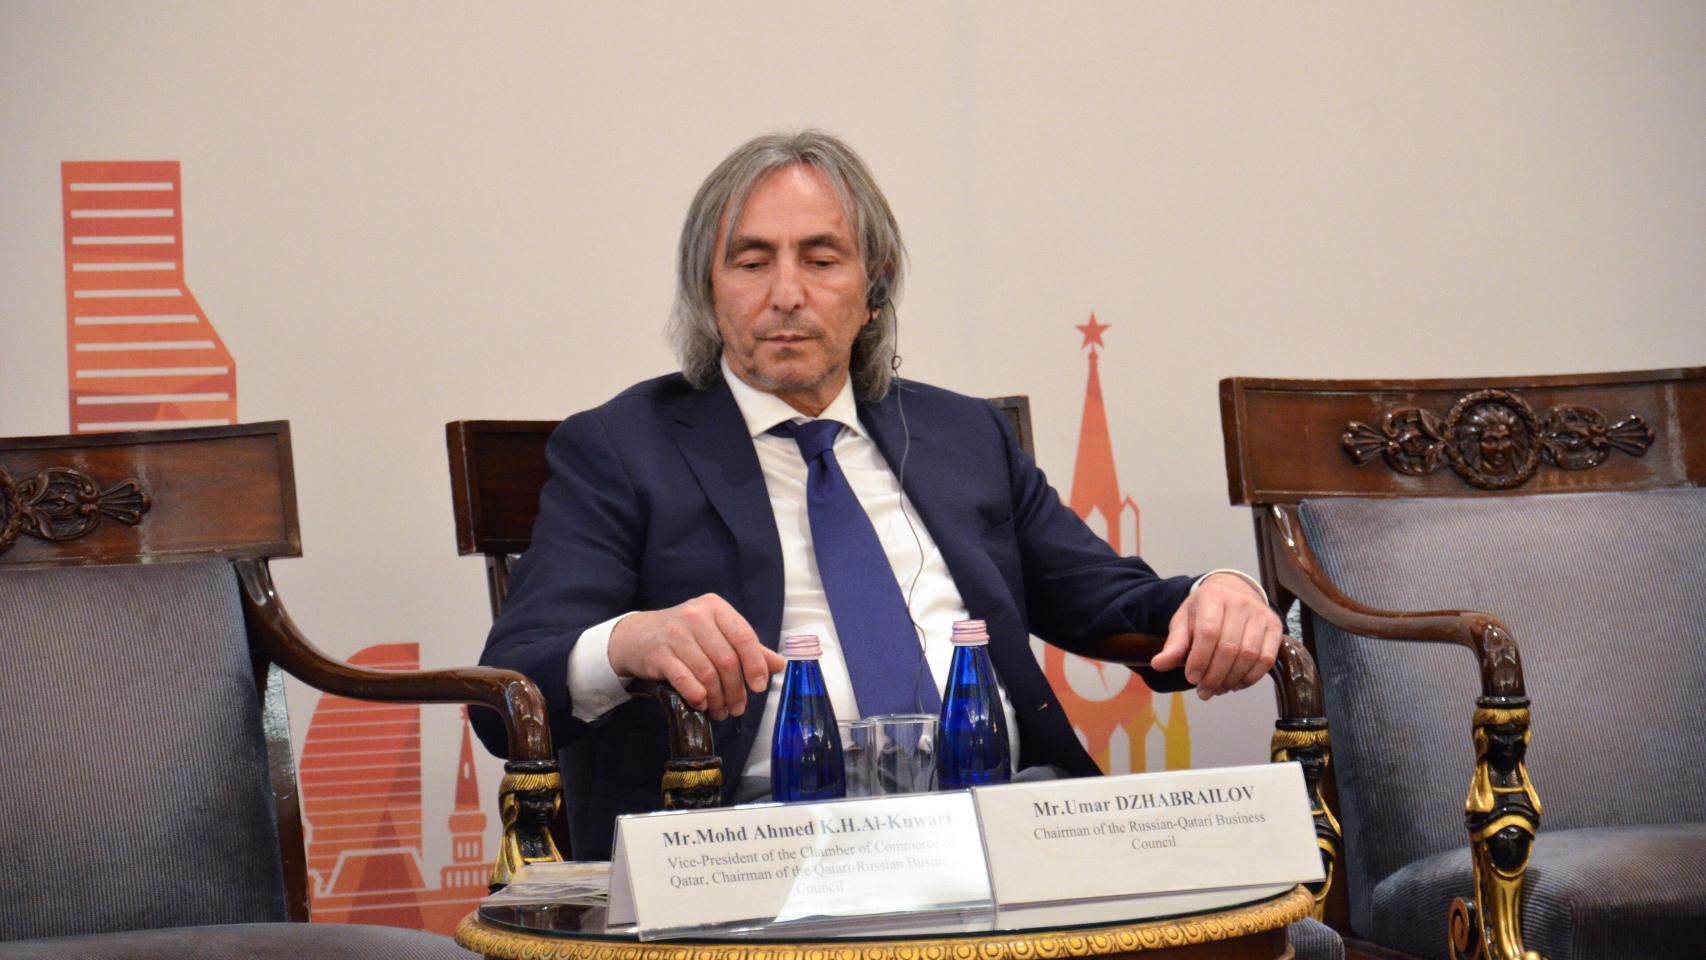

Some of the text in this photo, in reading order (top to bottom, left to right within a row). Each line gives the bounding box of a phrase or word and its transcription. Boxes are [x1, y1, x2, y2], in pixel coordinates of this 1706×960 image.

[1033, 786, 1256, 818] Mr.Umar DZHABRAILOV
[753, 821, 815, 840] Ahmed
[1033, 811, 1266, 841] Chairman of the Russian-Qatari Business
[667, 852, 759, 870] Vice-President
[761, 850, 777, 864] of
[779, 848, 797, 862] the
[799, 845, 855, 860] Chamber
[858, 841, 873, 854] of
[1131, 836, 1177, 850] Council
[711, 869, 773, 885] Chairman
[775, 867, 791, 880] of
[791, 865, 811, 879] the
[813, 858, 904, 878] Qatari-Russian
